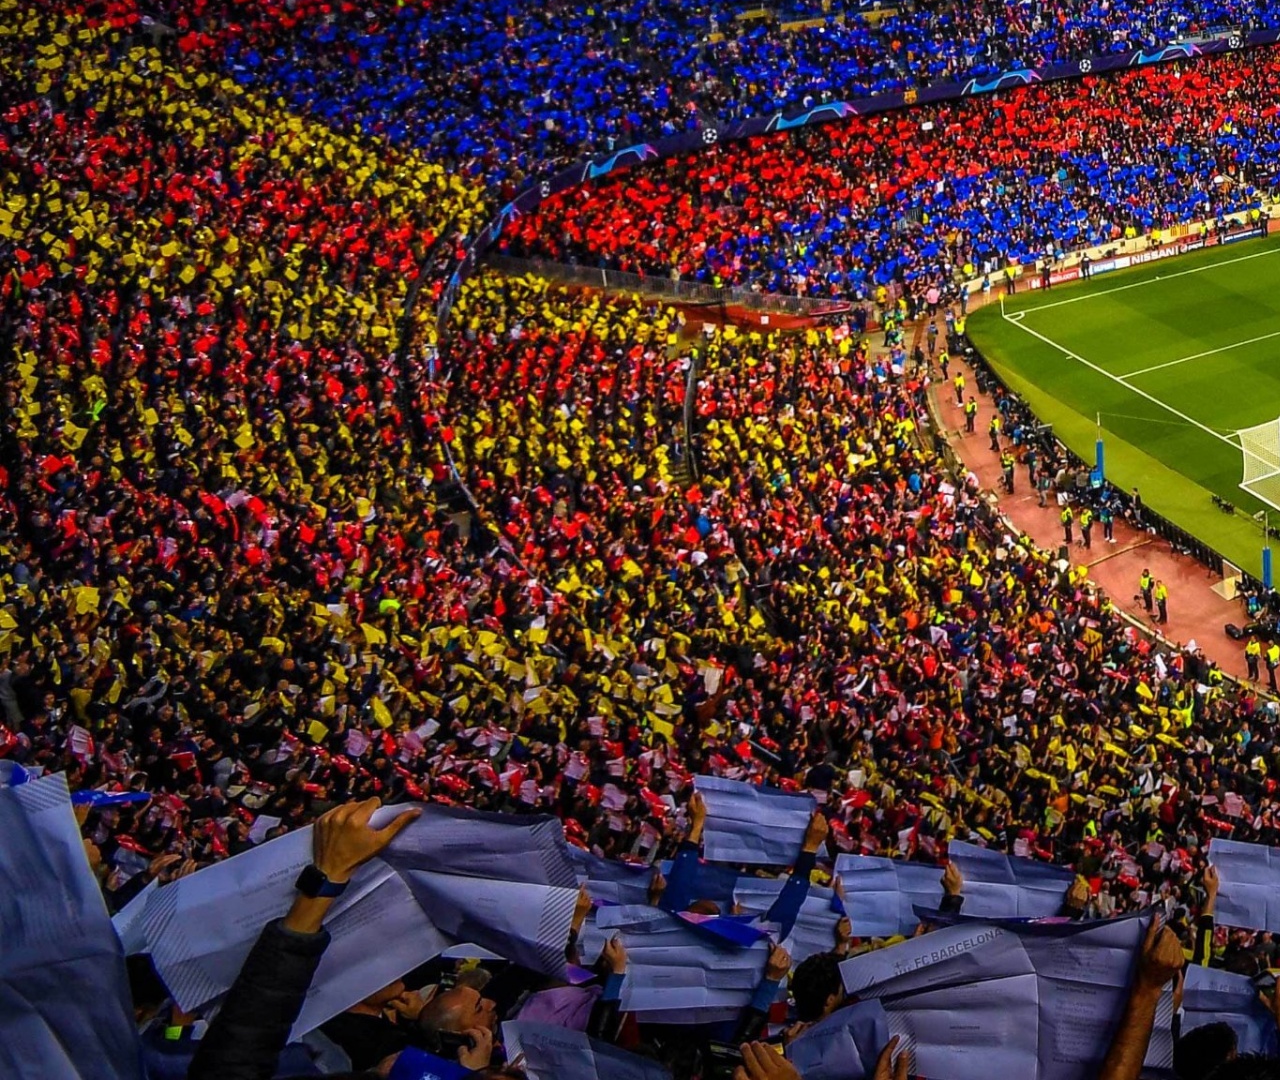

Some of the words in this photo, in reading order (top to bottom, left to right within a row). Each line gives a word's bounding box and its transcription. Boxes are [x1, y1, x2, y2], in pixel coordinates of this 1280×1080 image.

[1131, 246, 1175, 265] NISSAN
[914, 954, 929, 969] FC
[931, 927, 1004, 963] BARCELONA
